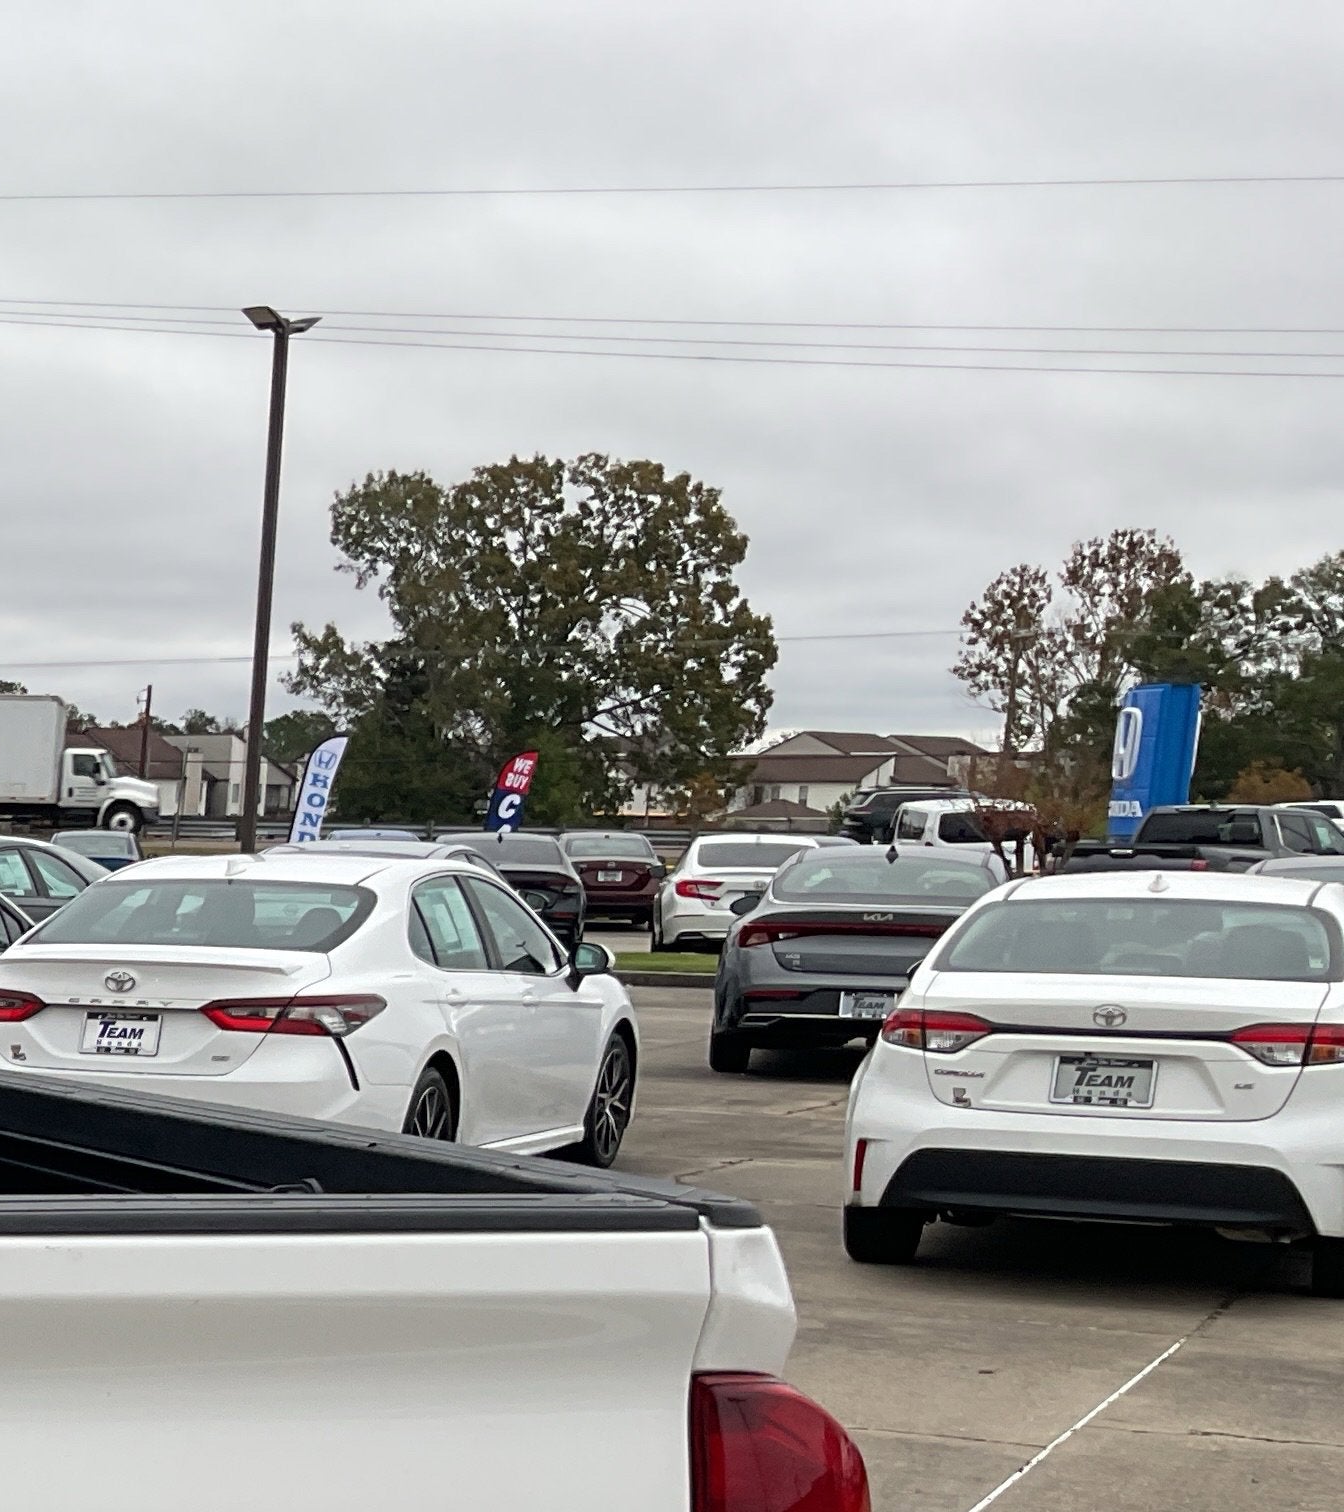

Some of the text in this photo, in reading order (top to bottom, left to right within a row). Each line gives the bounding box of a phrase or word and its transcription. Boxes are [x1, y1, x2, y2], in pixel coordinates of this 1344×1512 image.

[513, 757, 534, 774] WE
[504, 772, 529, 790] BUY
[863, 913, 894, 921] KIA
[98, 1020, 145, 1039] TEAM
[1074, 1066, 1136, 1088] TEAM
